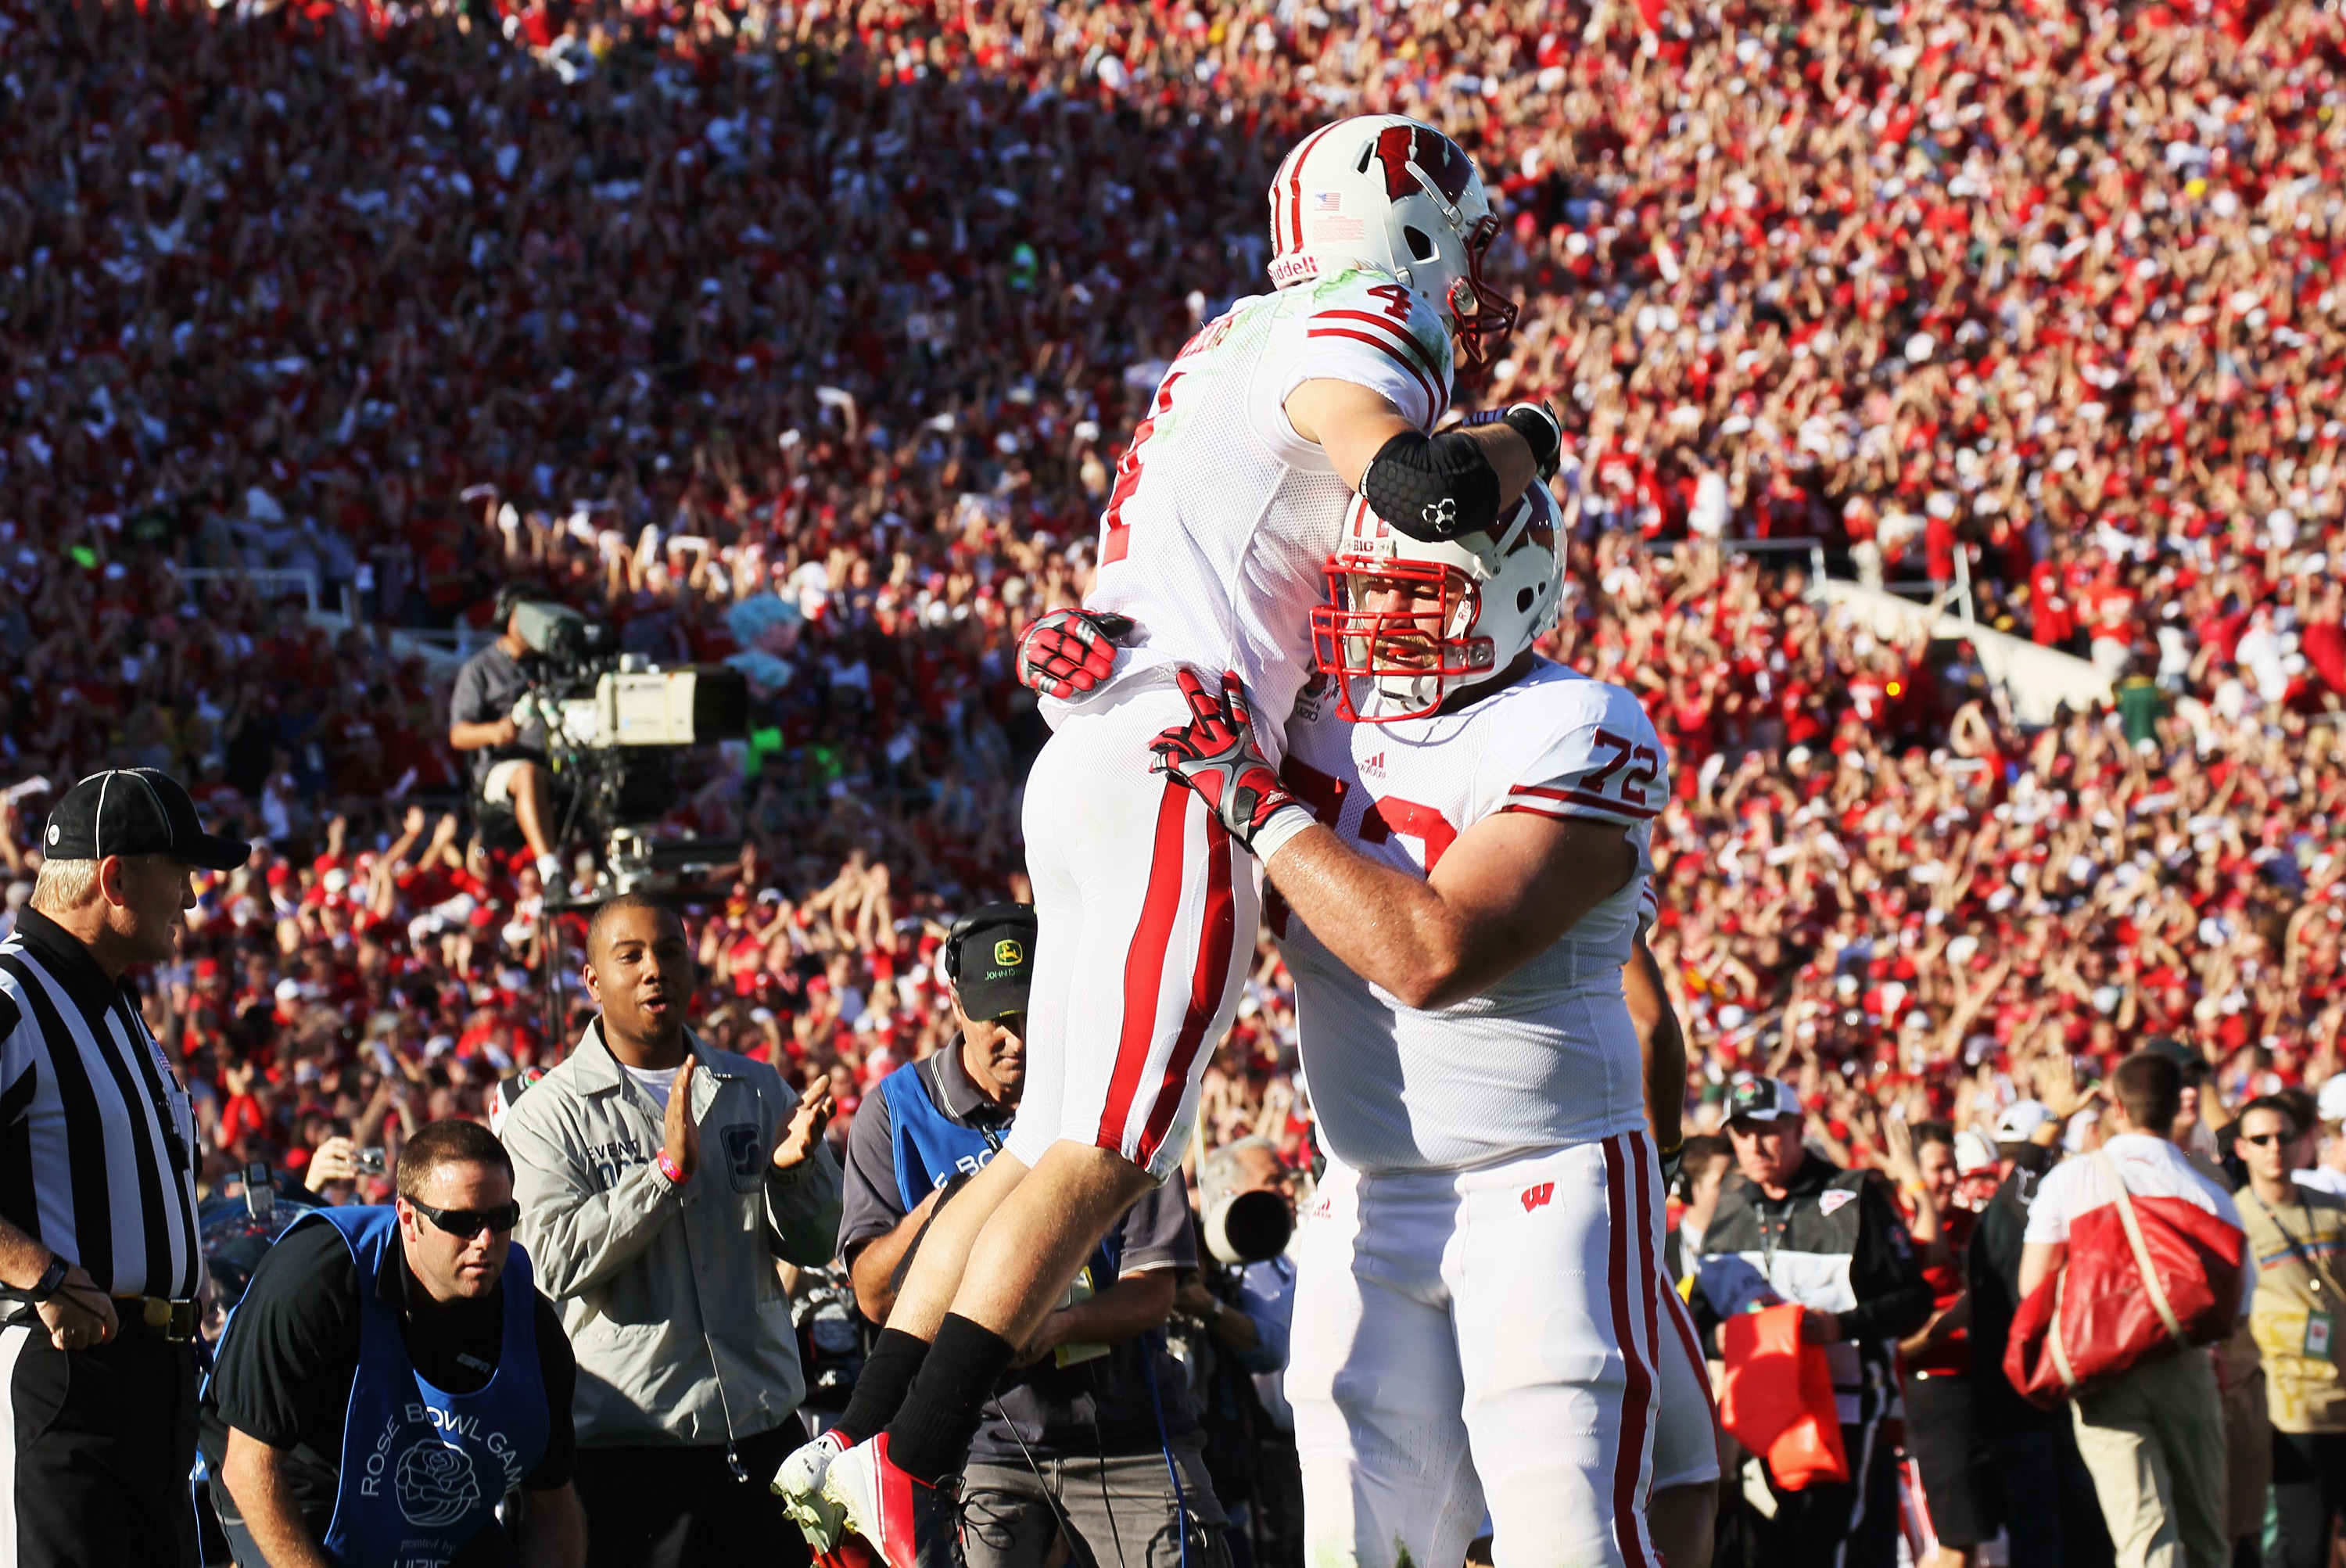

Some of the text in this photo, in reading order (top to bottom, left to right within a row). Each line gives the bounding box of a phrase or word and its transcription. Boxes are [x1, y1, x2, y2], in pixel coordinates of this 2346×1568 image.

[1366, 284, 1413, 324] 4
[1577, 727, 1658, 806] 72
[985, 969, 1007, 981] JOHN
[1521, 1182, 1555, 1213] W
[361, 1402, 523, 1497] ROSE BOWL GAM
